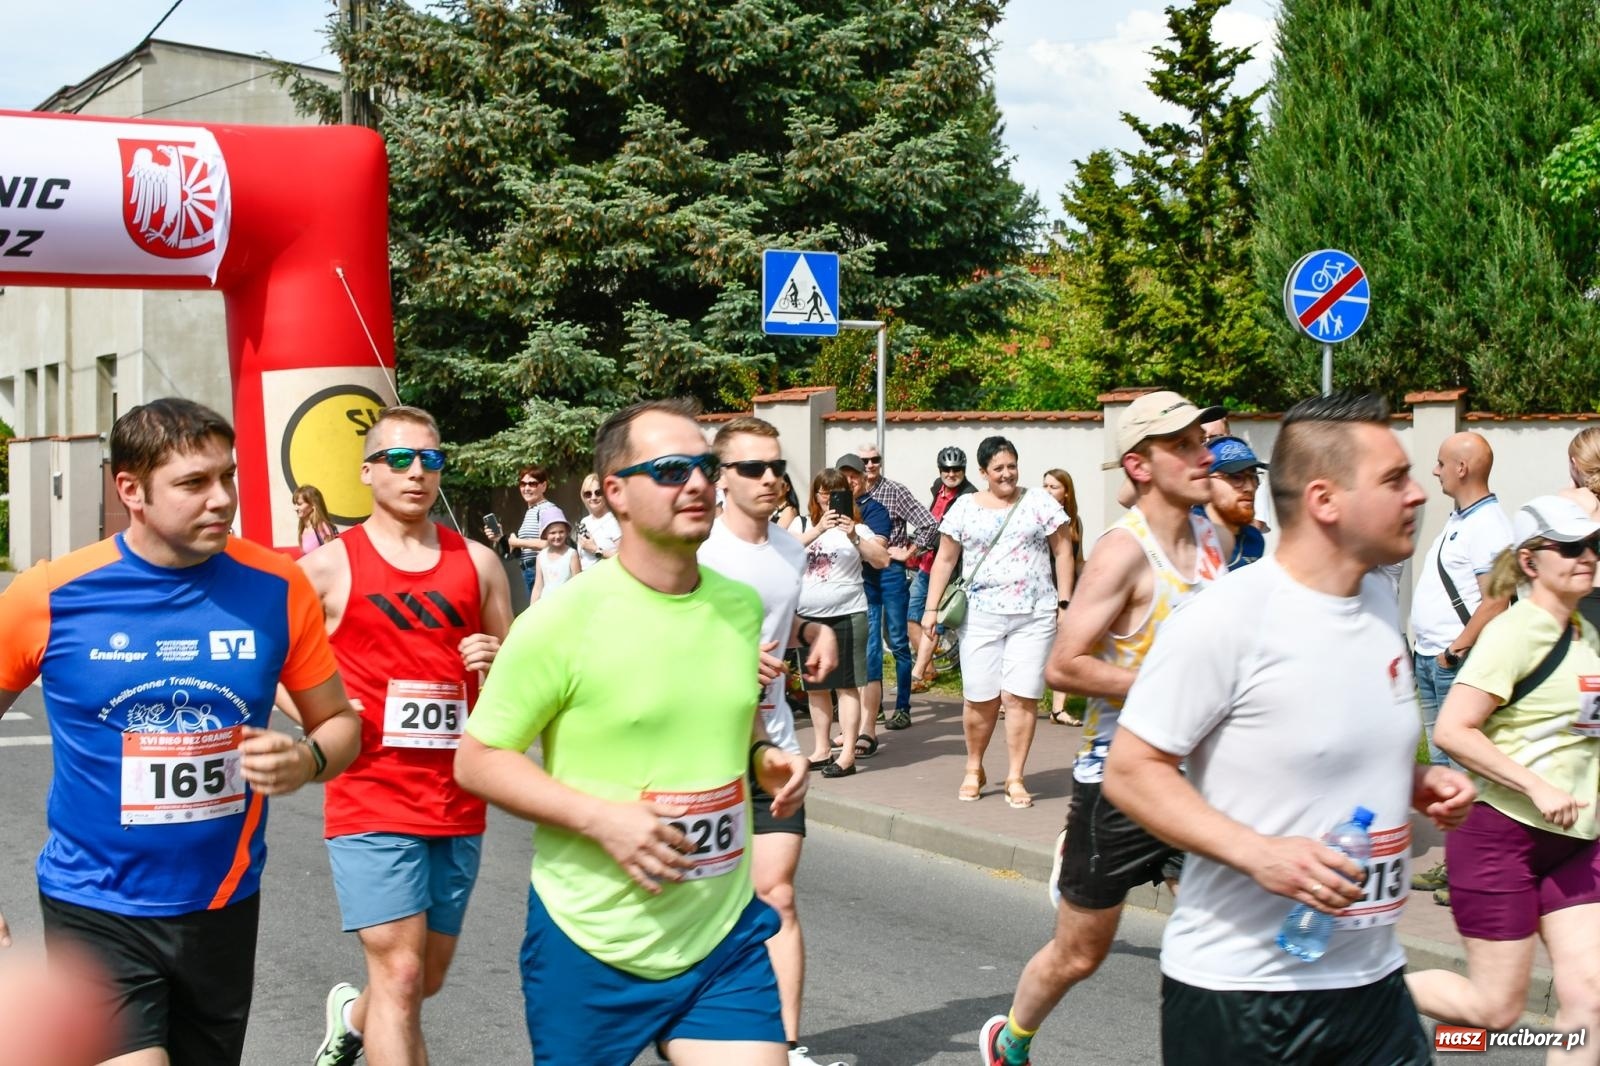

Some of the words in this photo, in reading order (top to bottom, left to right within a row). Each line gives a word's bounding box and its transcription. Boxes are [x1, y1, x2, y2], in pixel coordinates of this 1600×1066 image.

[89, 648, 149, 663] Ensinger
[109, 679, 167, 708] Heilbronner
[401, 702, 457, 730] 205
[150, 758, 226, 799] 165
